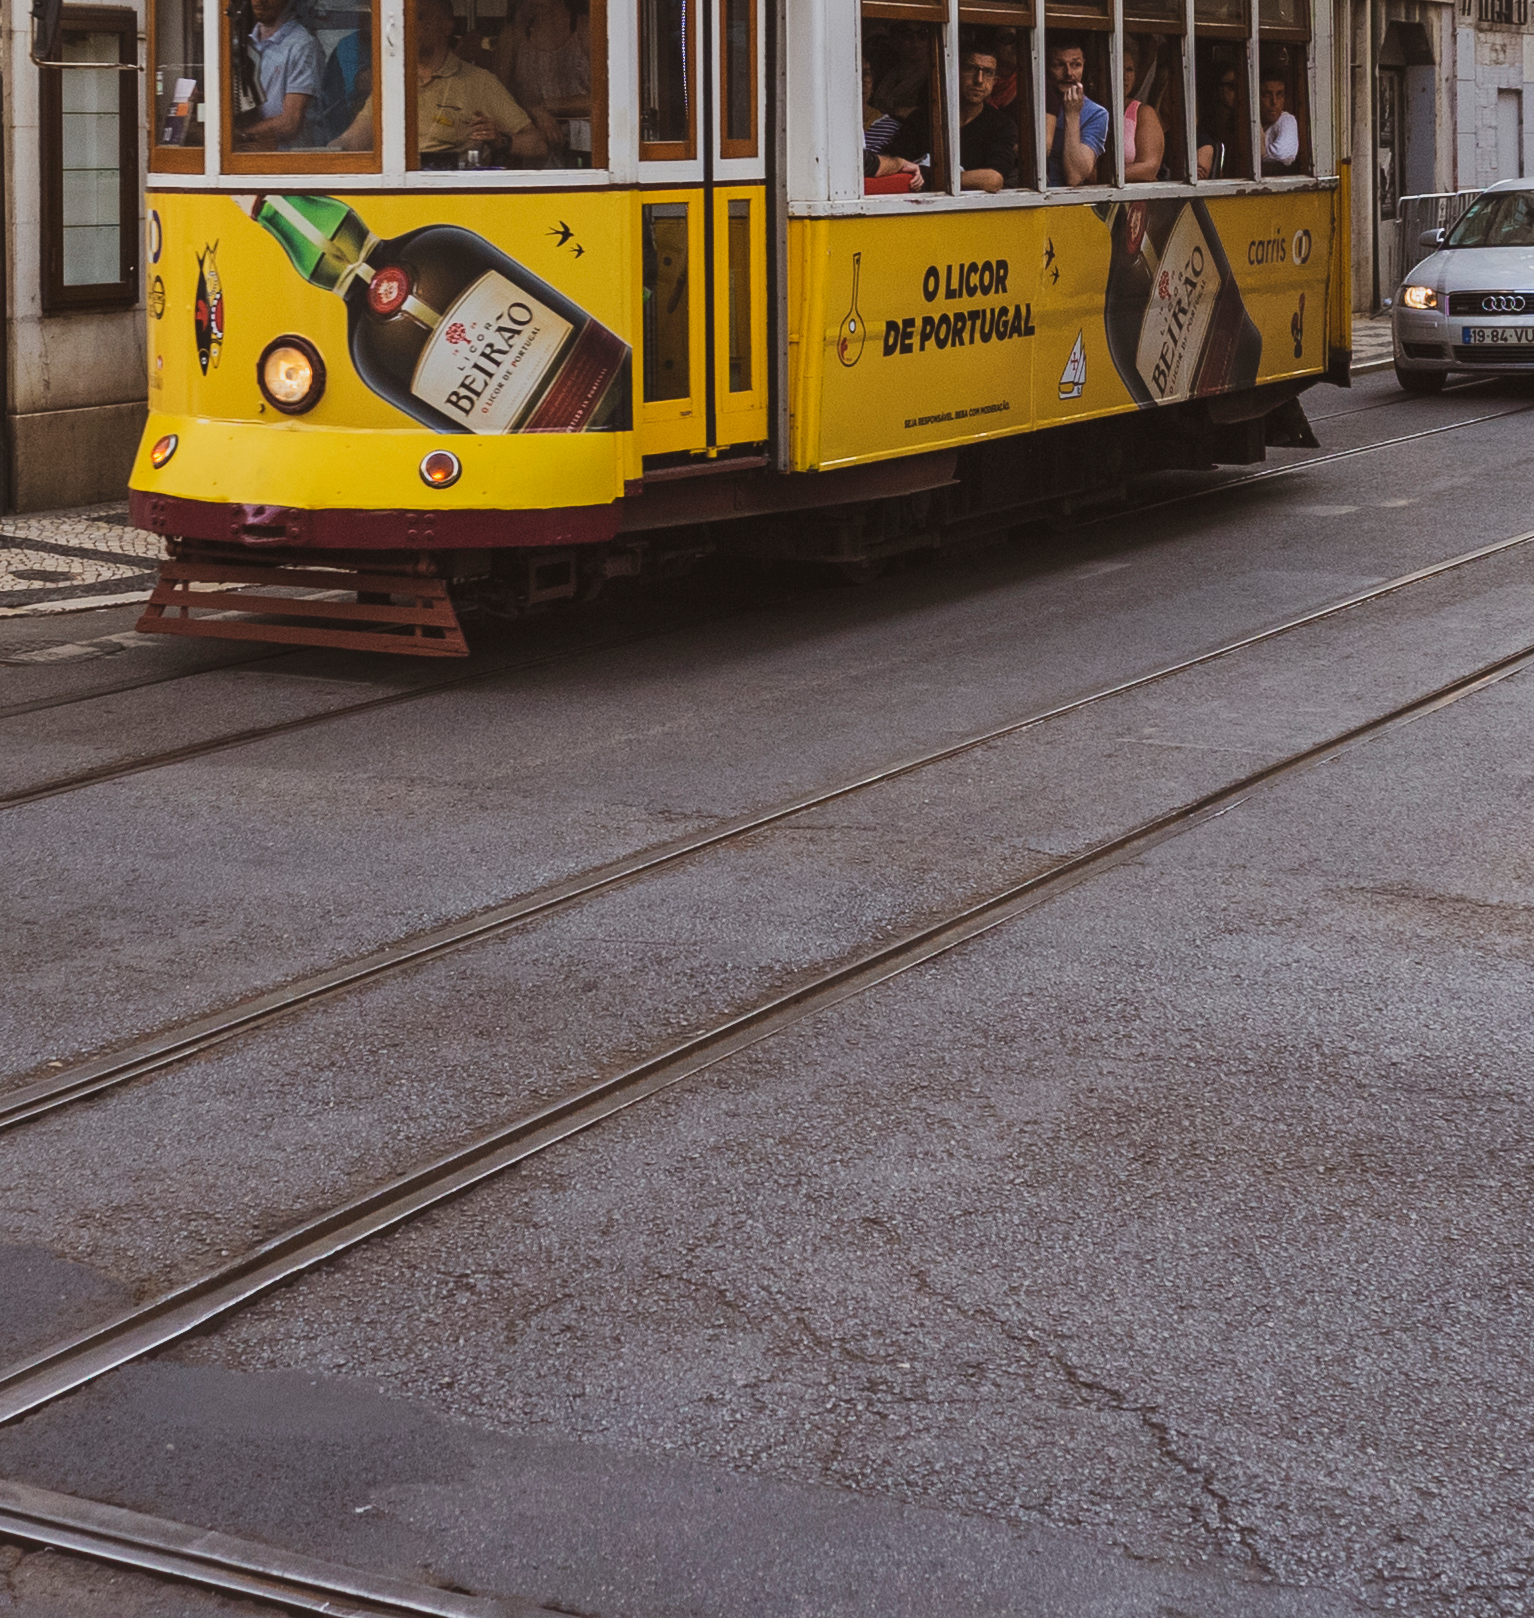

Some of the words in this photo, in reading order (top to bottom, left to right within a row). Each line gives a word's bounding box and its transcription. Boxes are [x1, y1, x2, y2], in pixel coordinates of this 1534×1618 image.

[1248, 228, 1286, 266] carris
[922, 265, 940, 303] O
[944, 259, 1009, 301] LICOR
[457, 322, 493, 372] LICOR
[882, 317, 916, 357] DE
[919, 303, 1036, 352] PORTUGAL
[1151, 245, 1204, 398] BEIRÃO
[444, 302, 533, 418] BEIRÃO
[487, 382, 505, 407] LICOR
[502, 370, 513, 382] DE
[511, 326, 541, 368] PORTUGAL
